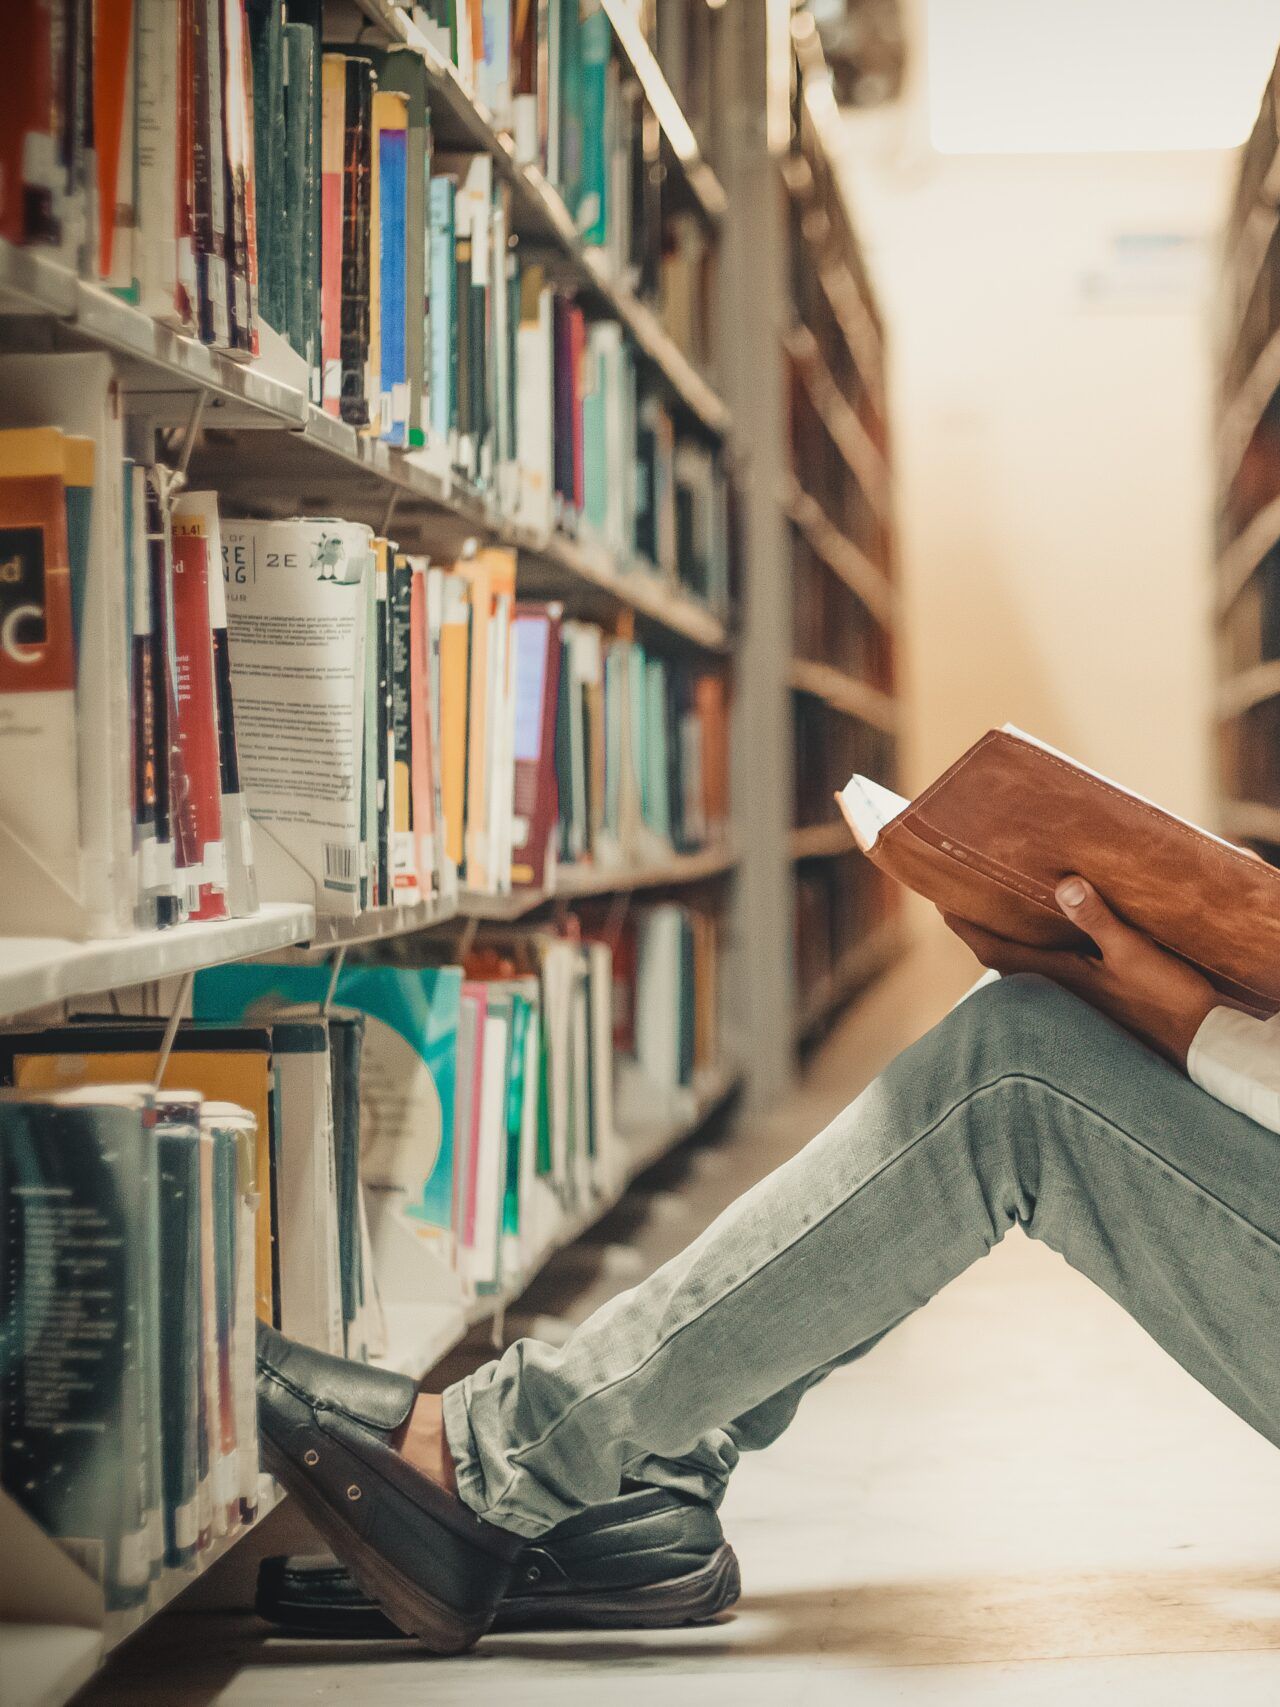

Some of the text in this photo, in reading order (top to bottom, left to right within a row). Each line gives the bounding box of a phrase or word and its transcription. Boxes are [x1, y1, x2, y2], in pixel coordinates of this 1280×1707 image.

[173, 559, 184, 574] d
[266, 554, 298, 568] 2E
[2, 604, 45, 664] C
